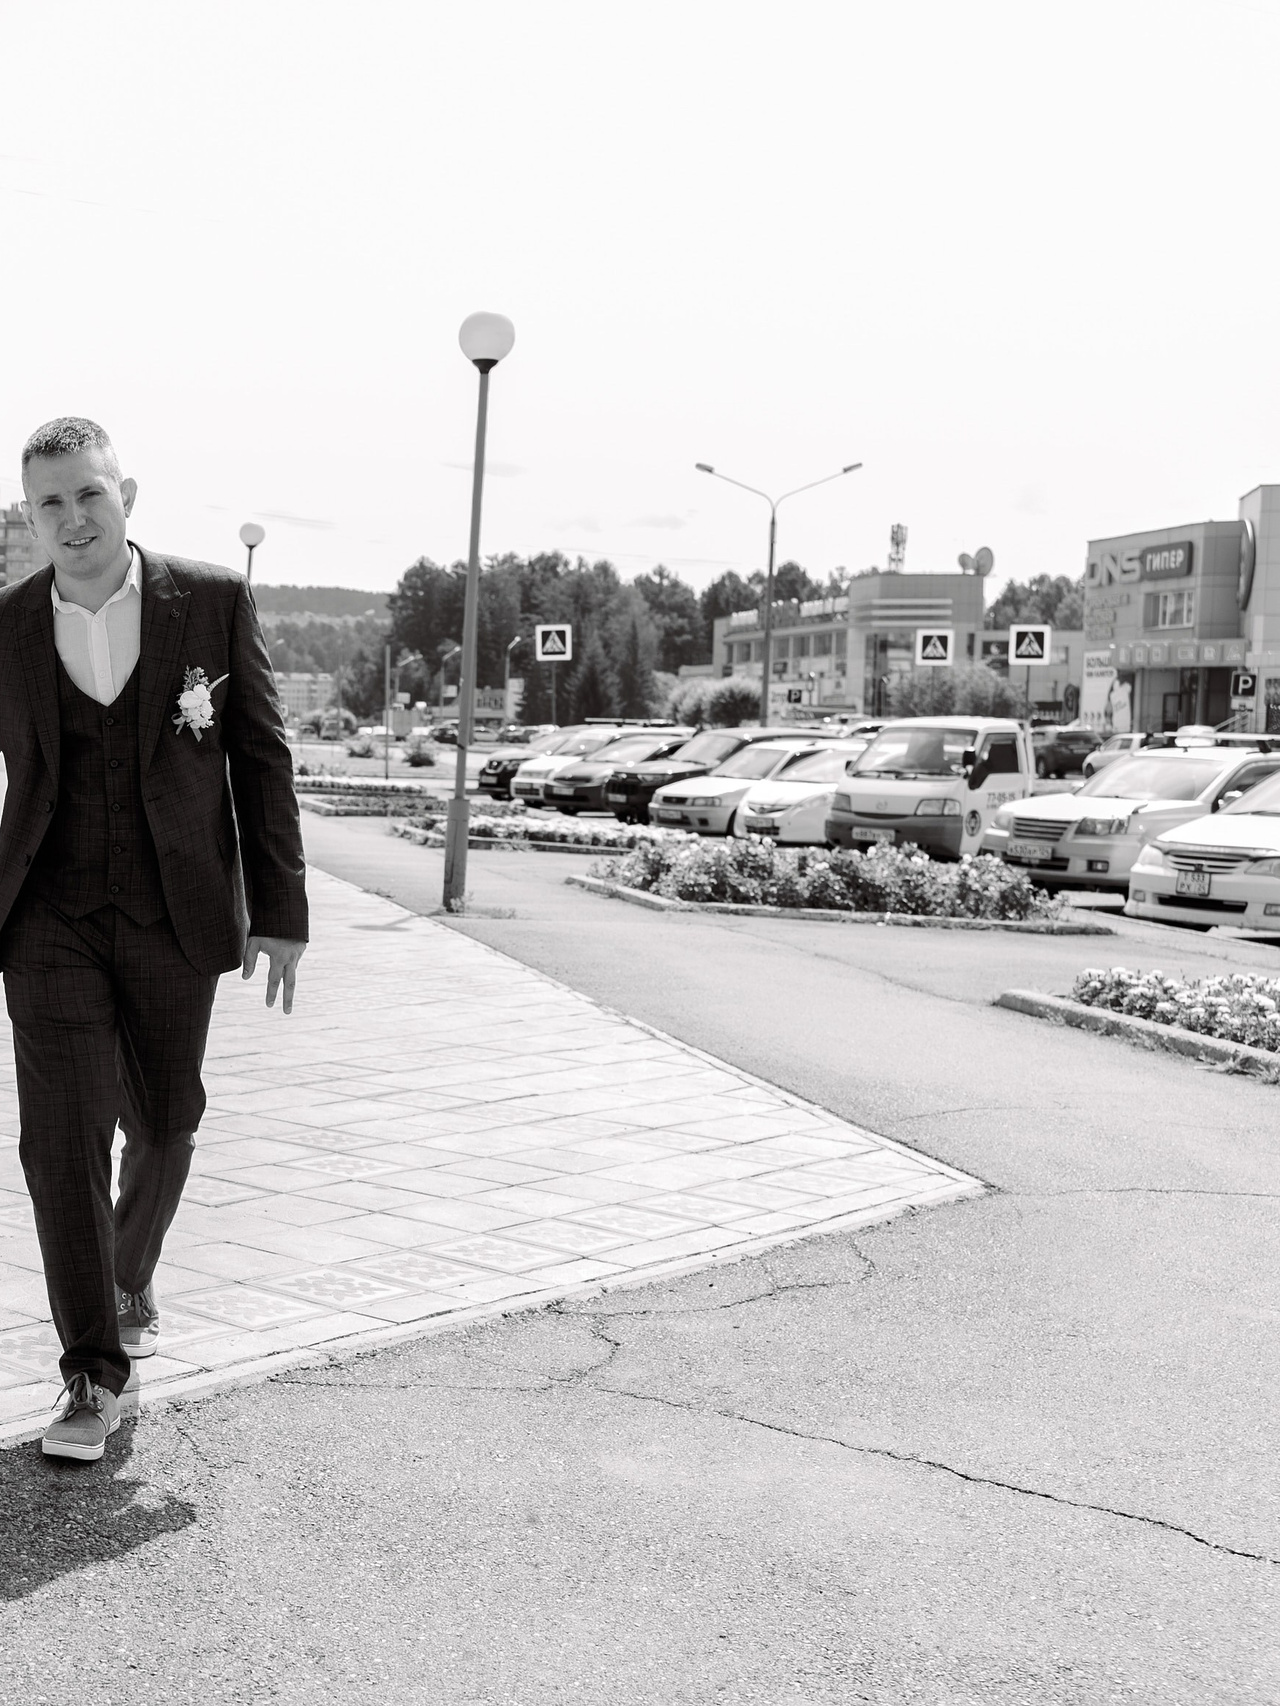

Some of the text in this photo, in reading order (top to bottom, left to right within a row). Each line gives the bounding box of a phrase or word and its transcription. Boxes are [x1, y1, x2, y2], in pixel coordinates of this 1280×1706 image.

[1086, 548, 1185, 588] DNS ГИПЕР
[1238, 675, 1253, 695] P
